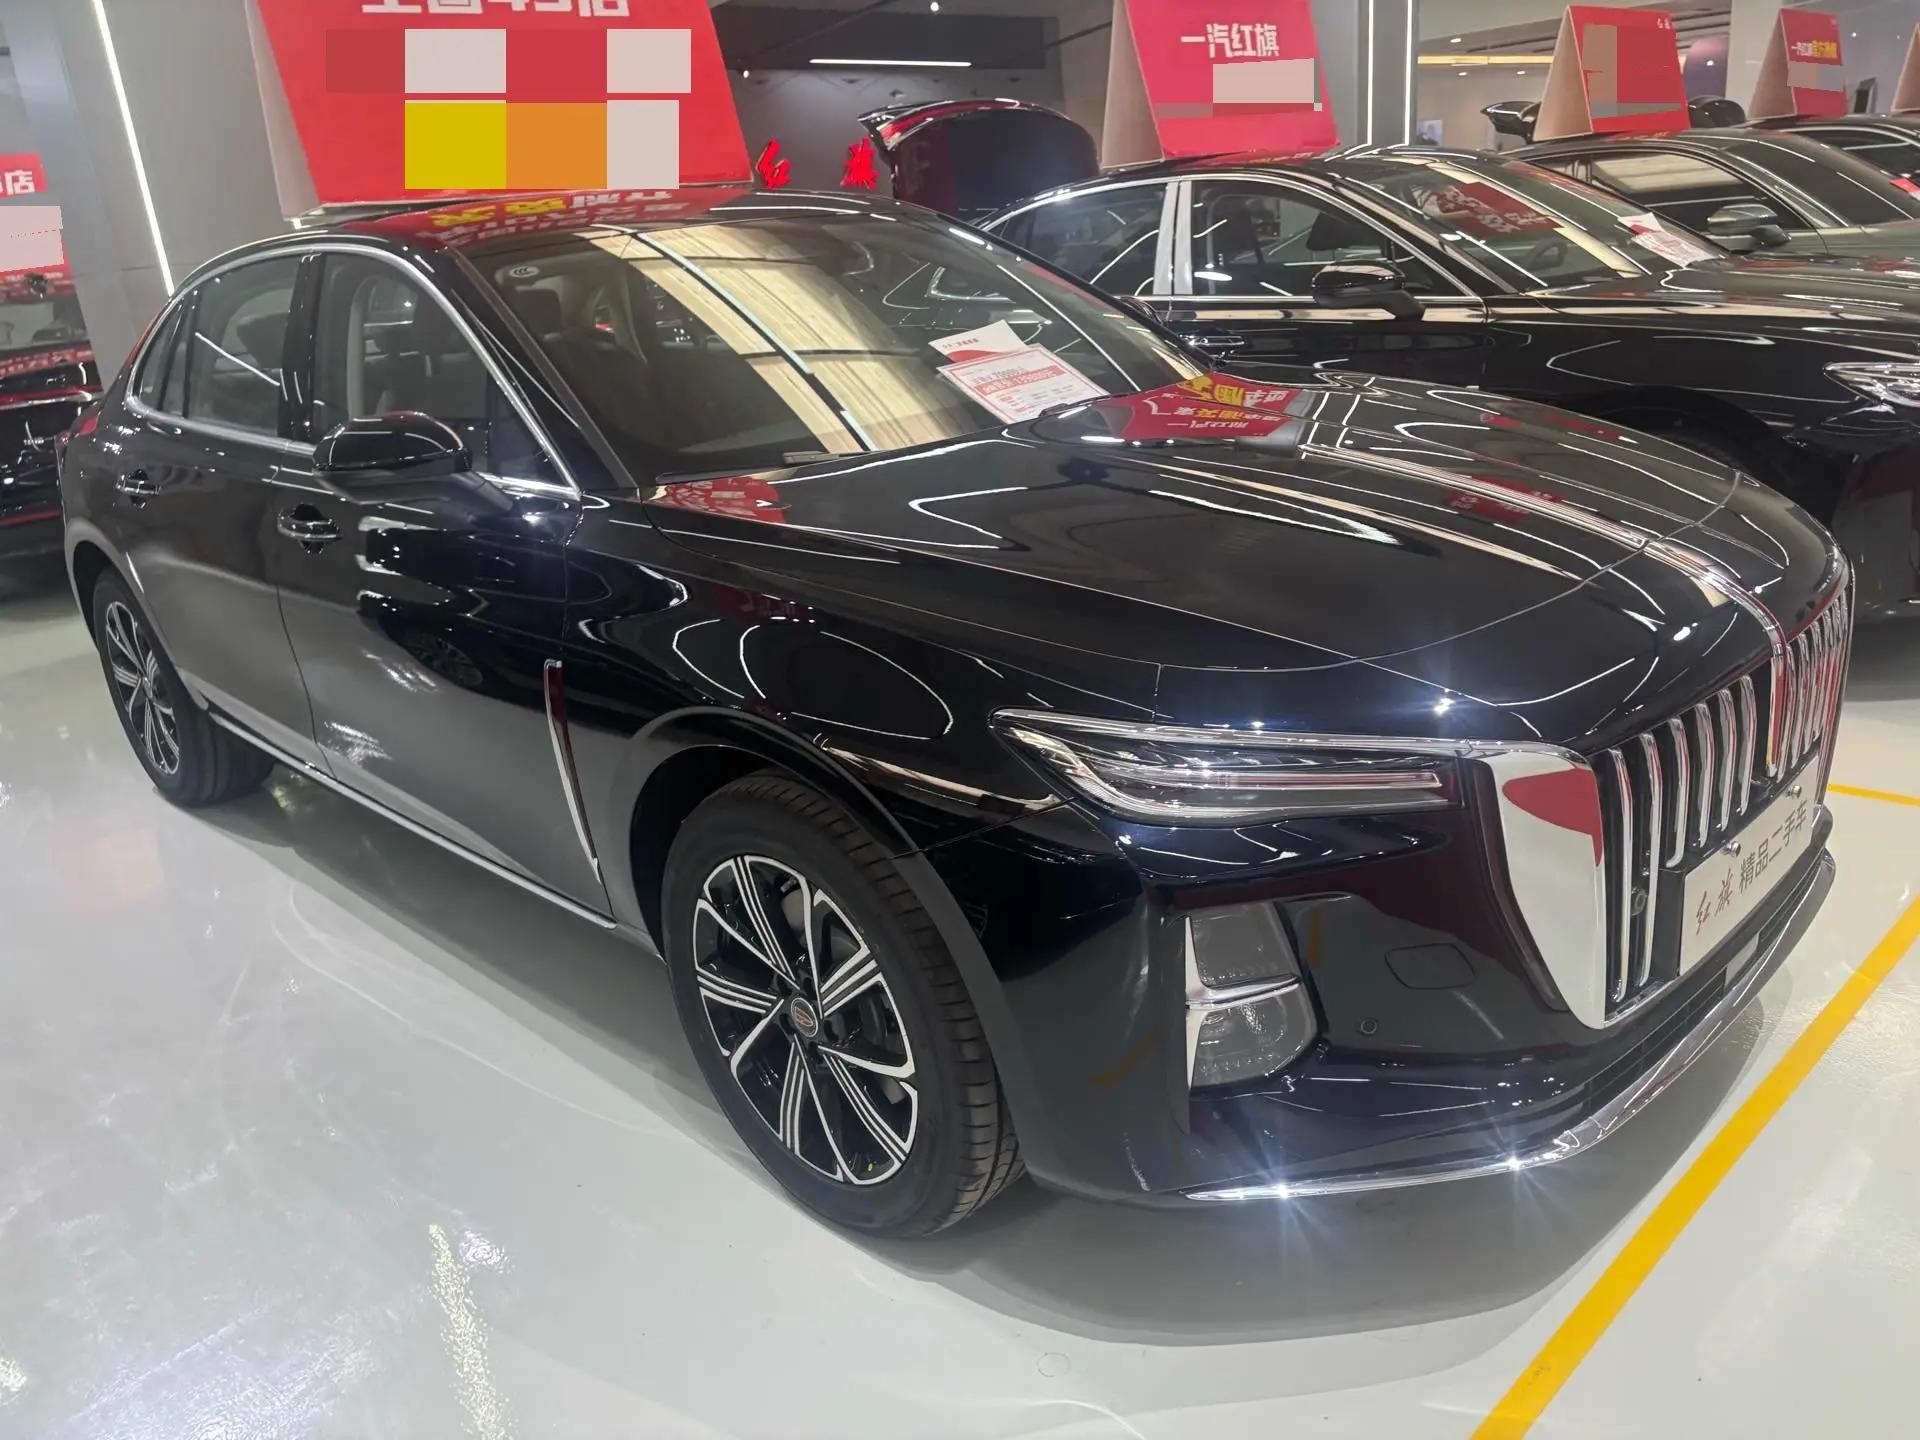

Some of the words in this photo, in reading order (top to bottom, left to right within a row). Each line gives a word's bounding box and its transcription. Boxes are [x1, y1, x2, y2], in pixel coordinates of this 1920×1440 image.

[1180, 23, 1280, 58] 一汽红旗
[0, 169, 35, 195] 店
[1740, 799, 1807, 895] 精品二手车
